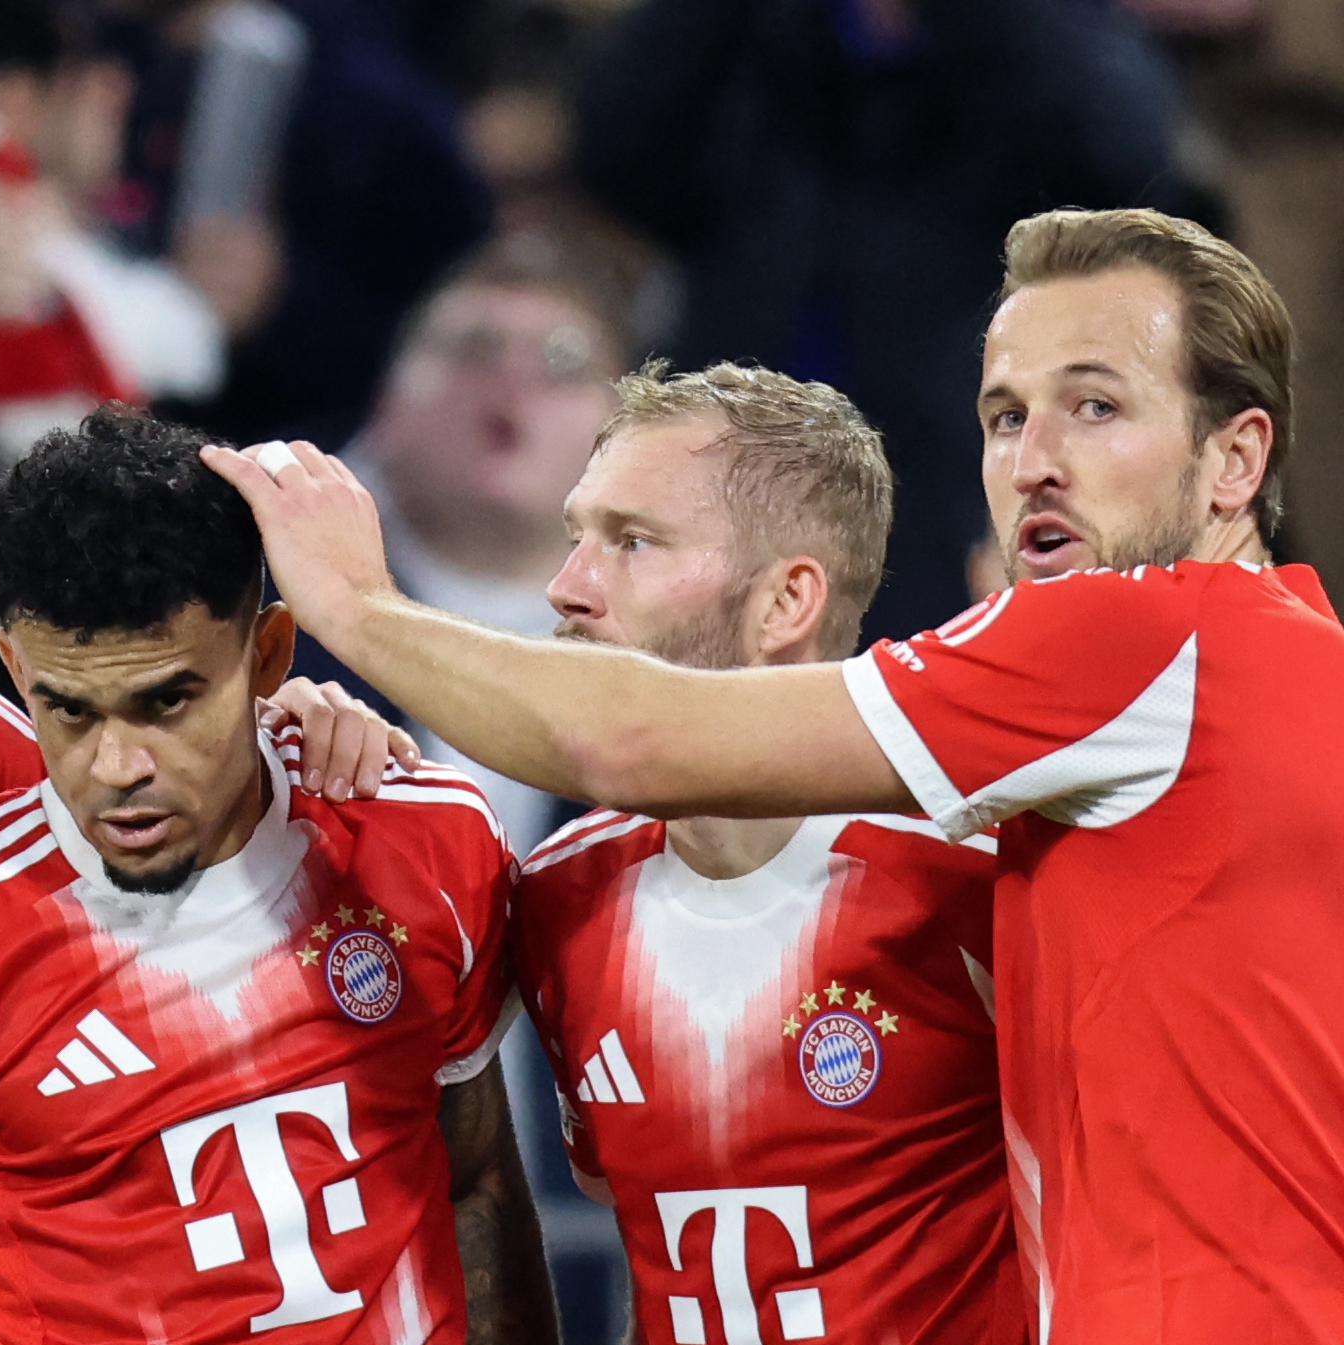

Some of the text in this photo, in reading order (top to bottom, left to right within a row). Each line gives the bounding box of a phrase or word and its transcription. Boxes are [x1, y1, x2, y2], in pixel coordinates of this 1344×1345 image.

[332, 937, 391, 976] FC BAYERN
[804, 1020, 871, 1055] FC BAYERN
[160, 1081, 367, 1334] T
